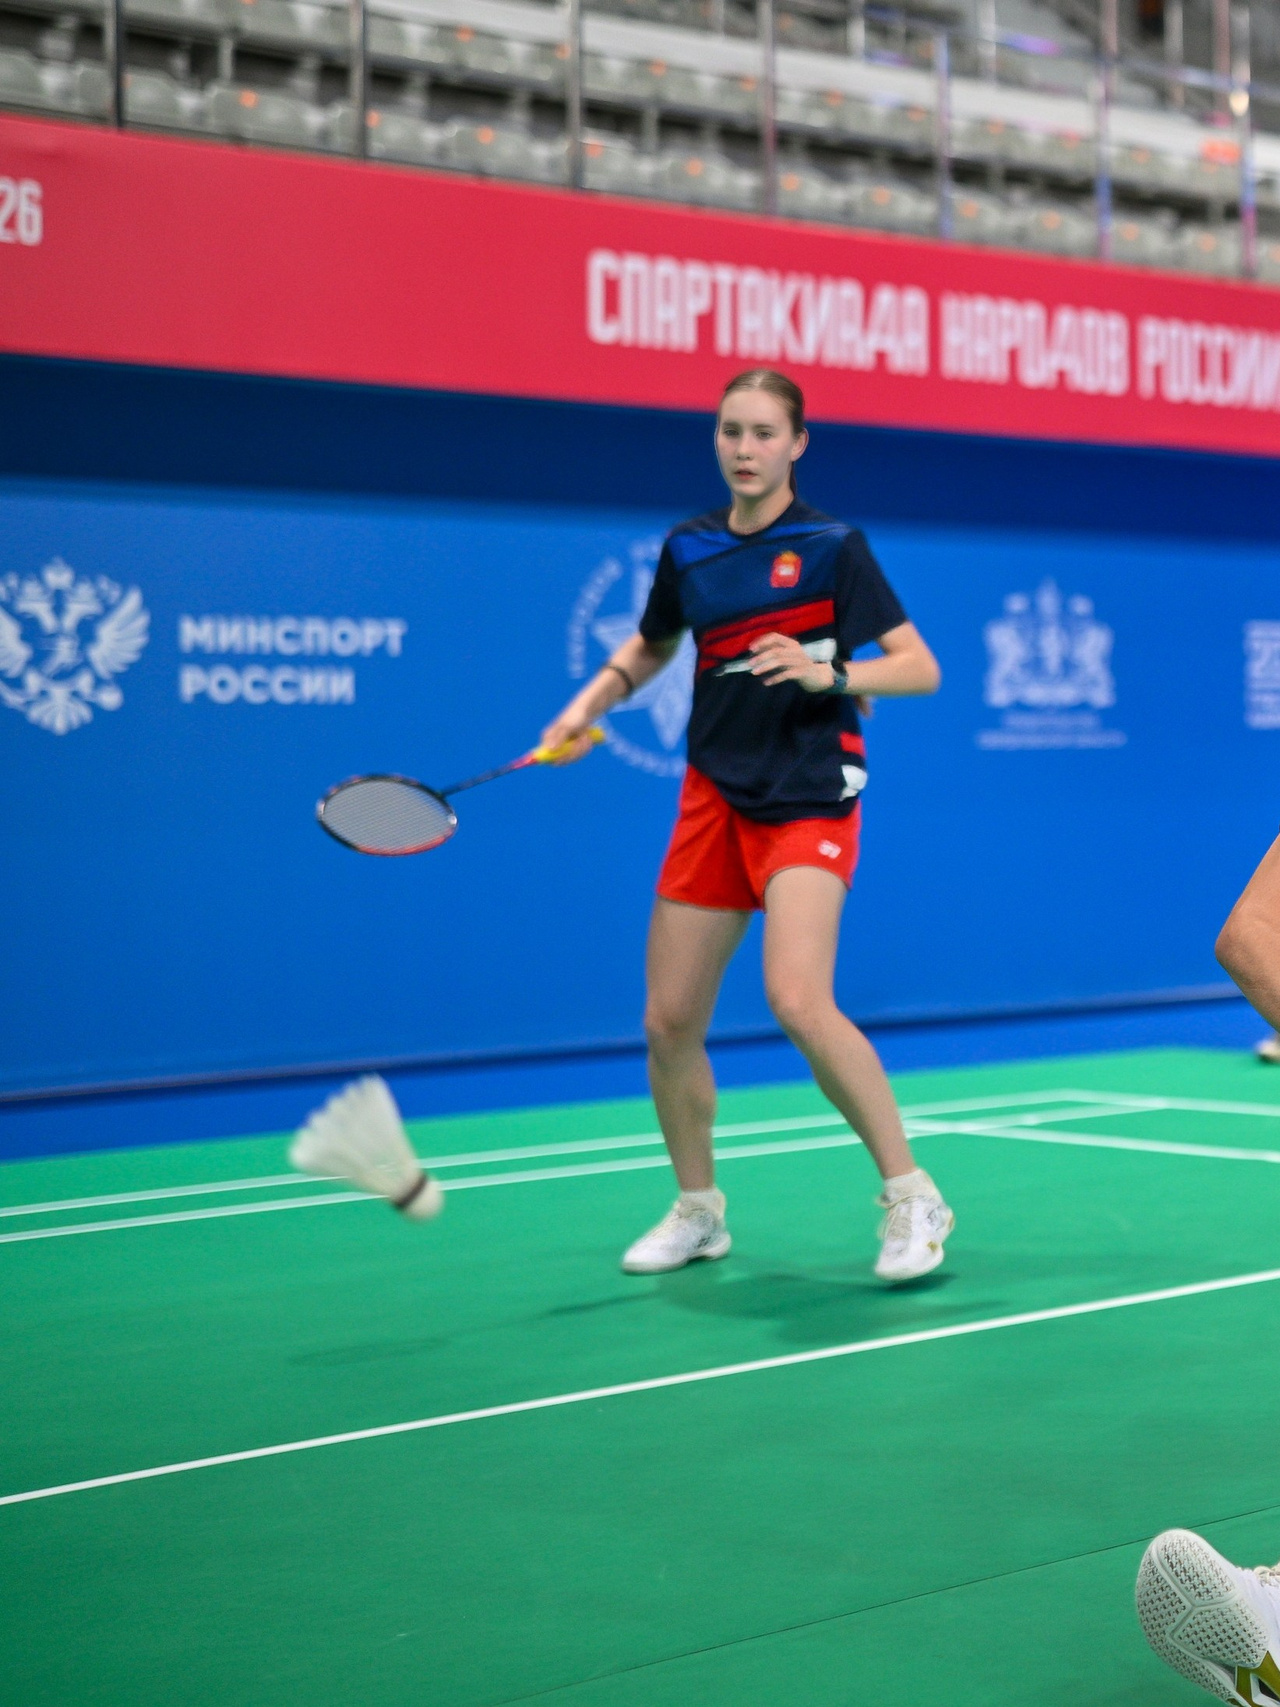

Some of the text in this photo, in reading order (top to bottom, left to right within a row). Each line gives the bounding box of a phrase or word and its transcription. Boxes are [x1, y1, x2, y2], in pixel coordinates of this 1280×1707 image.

[586, 248, 931, 377] СПАРТАКИАДА
[940, 290, 1130, 398] НАРОДОВ
[179, 614, 408, 657] МИНСПОРТ
[180, 663, 357, 705] РОССИИ
